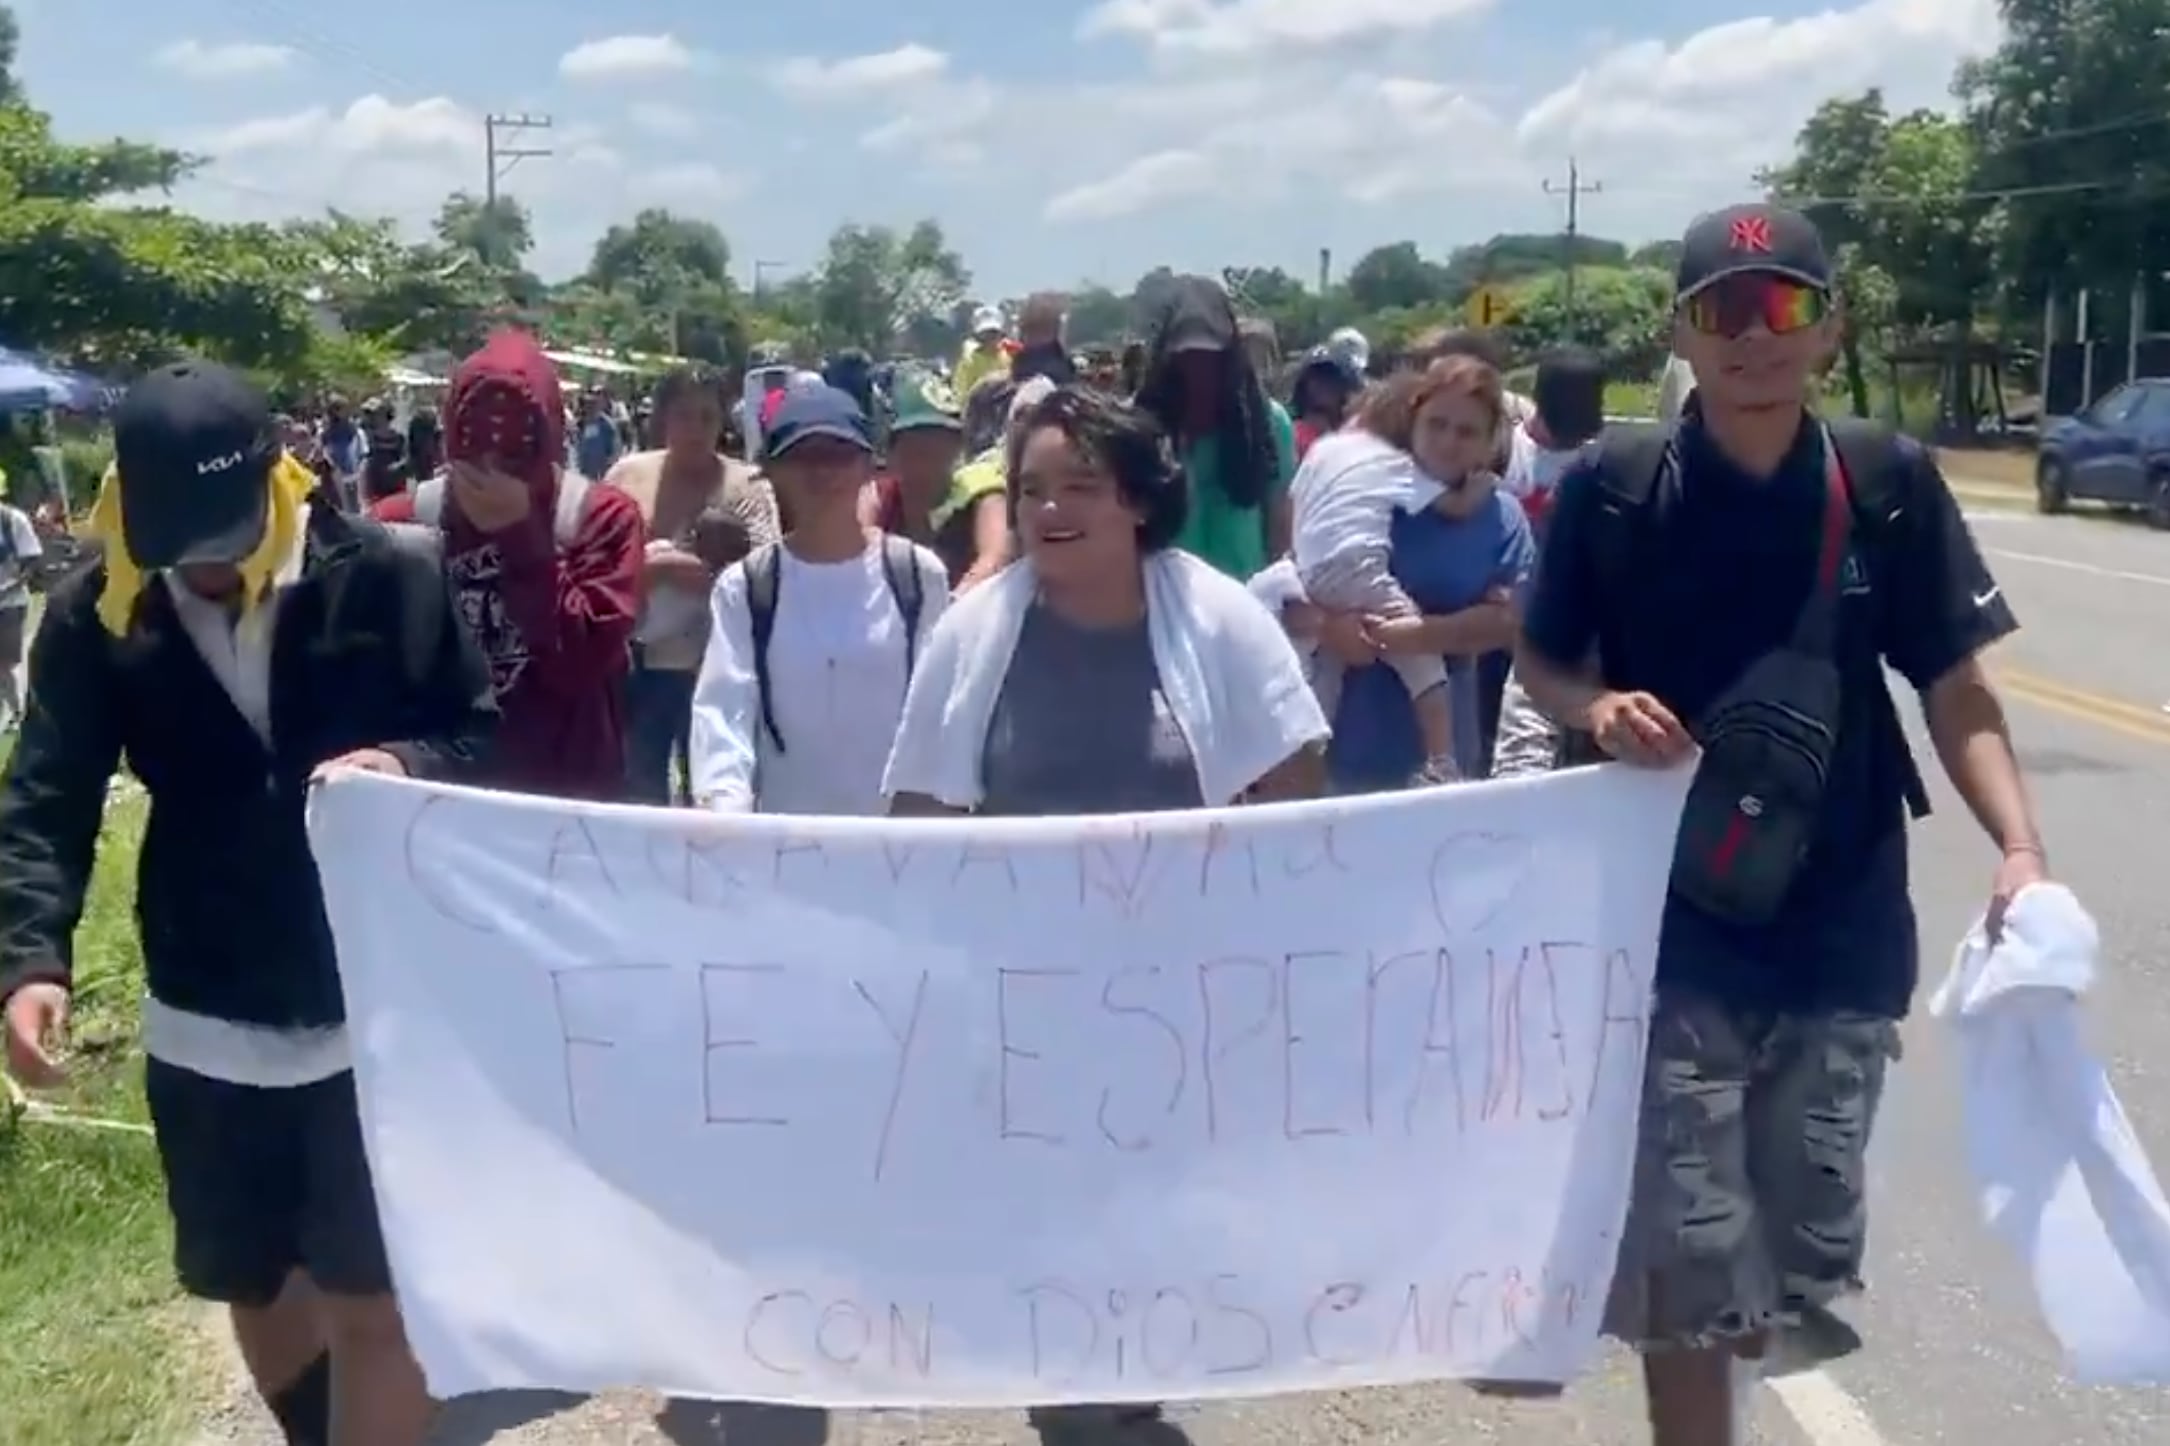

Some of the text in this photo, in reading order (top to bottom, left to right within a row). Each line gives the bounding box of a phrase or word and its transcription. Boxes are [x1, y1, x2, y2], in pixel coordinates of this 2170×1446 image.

[1730, 218, 1773, 252] NY
[550, 962, 788, 1130] FE
[850, 970, 930, 1183] Y
[744, 1288, 935, 1378] CON
